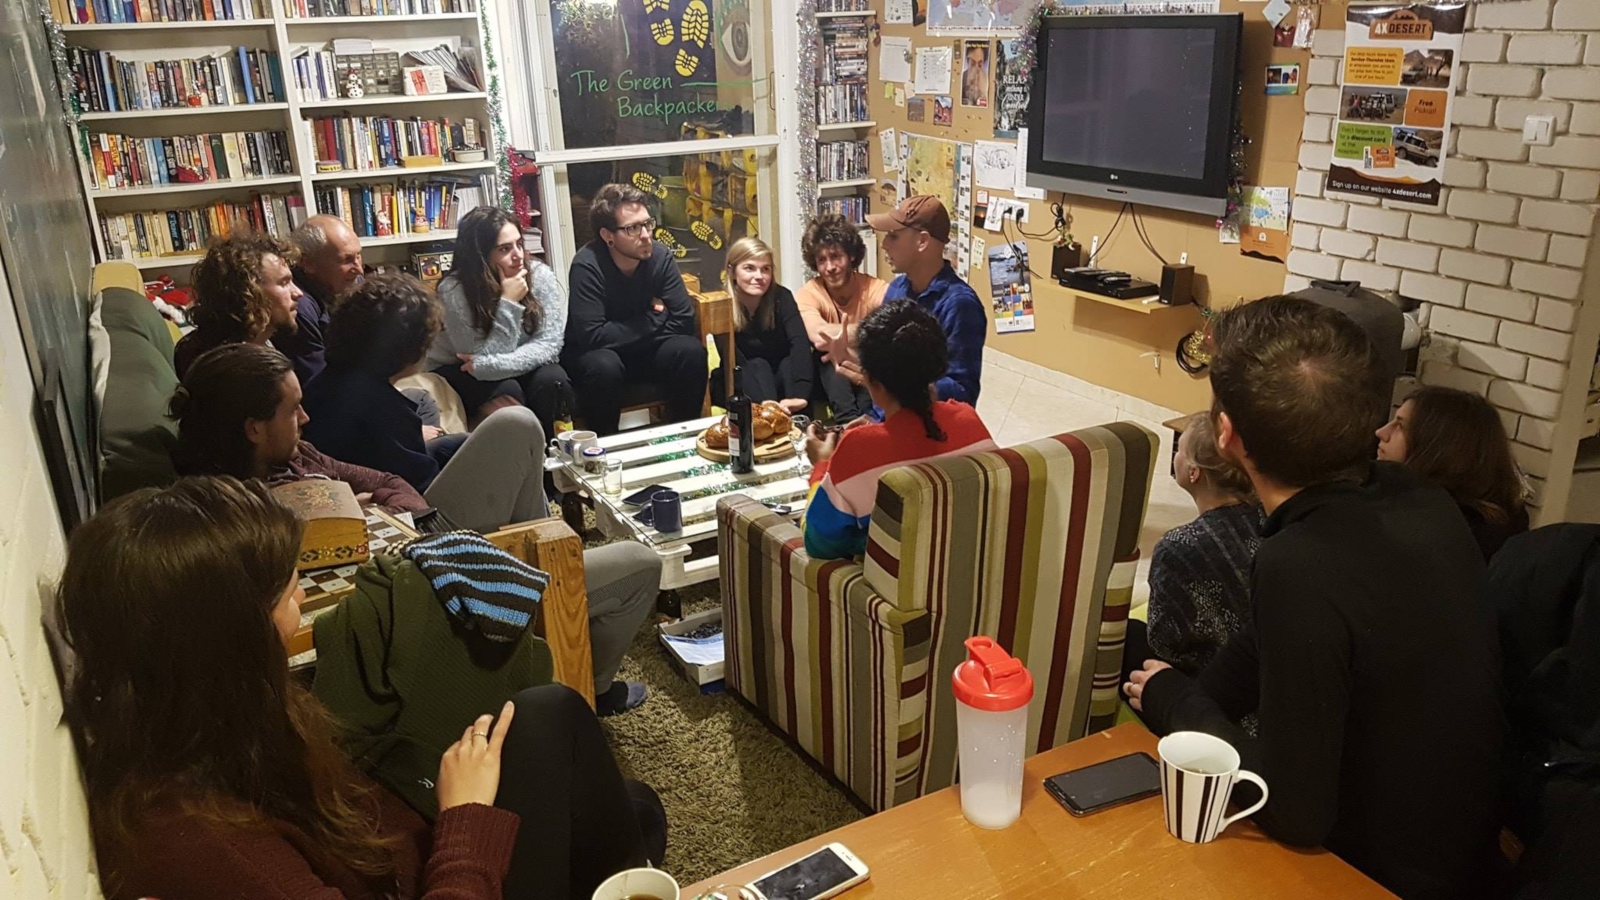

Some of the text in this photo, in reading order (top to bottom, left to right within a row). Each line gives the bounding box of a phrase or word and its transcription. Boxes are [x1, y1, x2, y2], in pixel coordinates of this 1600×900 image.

[570, 69, 673, 96] The Green
[1332, 180, 1344, 188] Sign
[1370, 186, 1392, 194] website
[1392, 189, 1432, 199] 4xdesert.com
